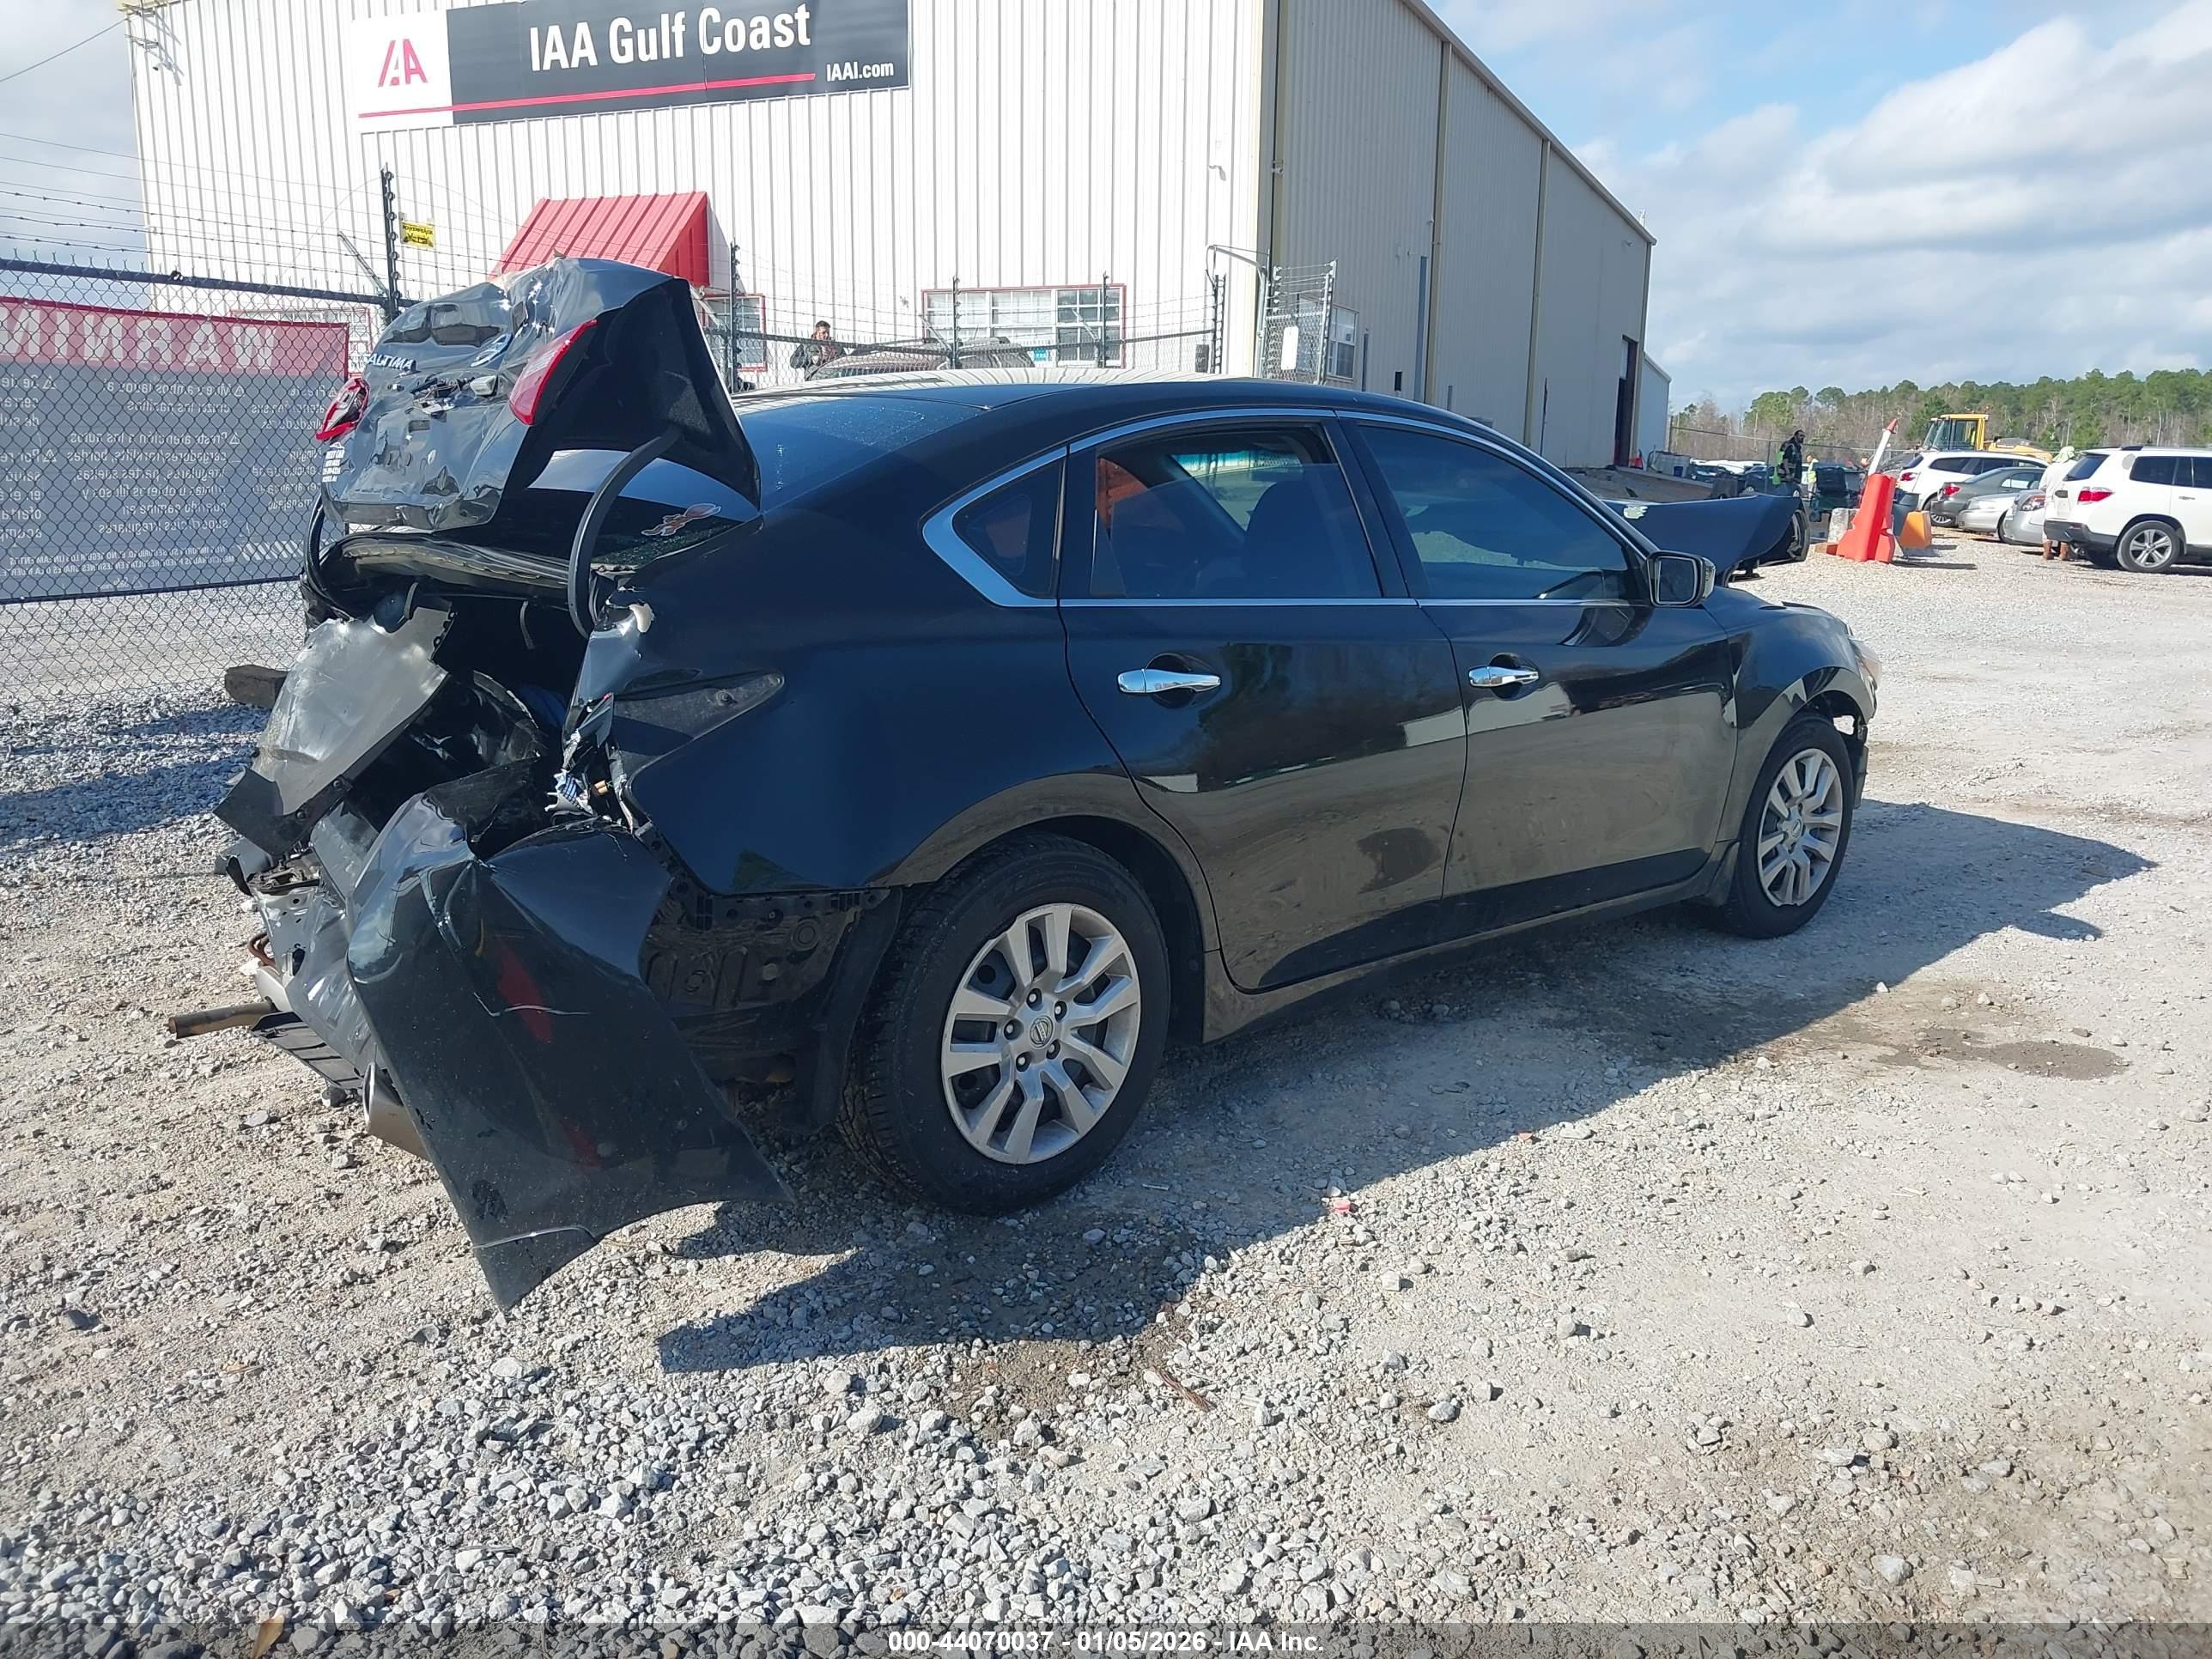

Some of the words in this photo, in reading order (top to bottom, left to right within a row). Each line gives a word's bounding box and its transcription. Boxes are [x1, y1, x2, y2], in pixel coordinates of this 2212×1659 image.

[529, 21, 599, 71] IAA
[608, 11, 686, 64] Gulf
[697, 3, 811, 55] Coast
[826, 61, 895, 82] IAAI.com
[368, 353, 414, 370] ALTIMA
